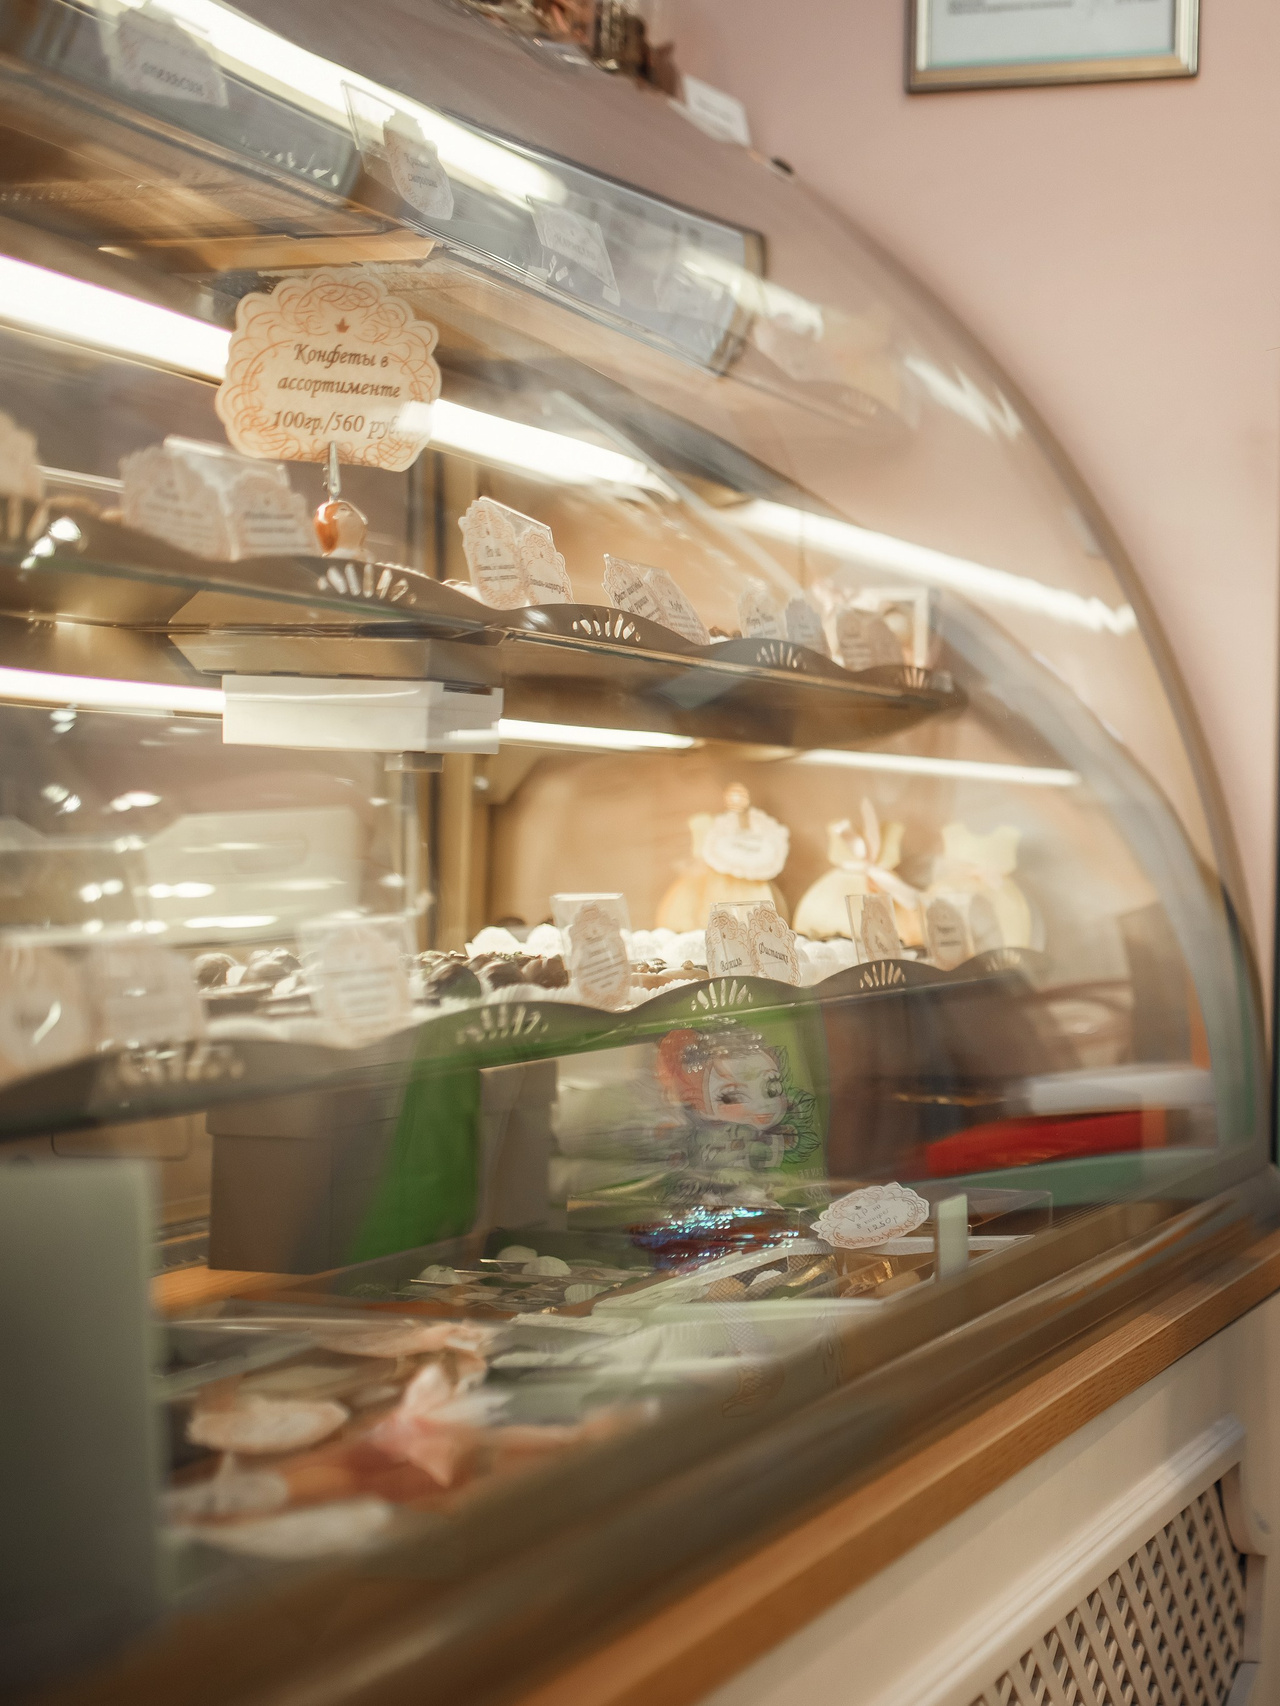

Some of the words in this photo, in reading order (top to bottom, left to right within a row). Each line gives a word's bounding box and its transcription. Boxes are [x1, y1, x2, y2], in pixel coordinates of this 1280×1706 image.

[293, 343, 376, 369] Конфеты
[380, 355, 389, 368] в
[277, 375, 401, 398] ассортименте
[273, 410, 365, 435] 100гр./560
